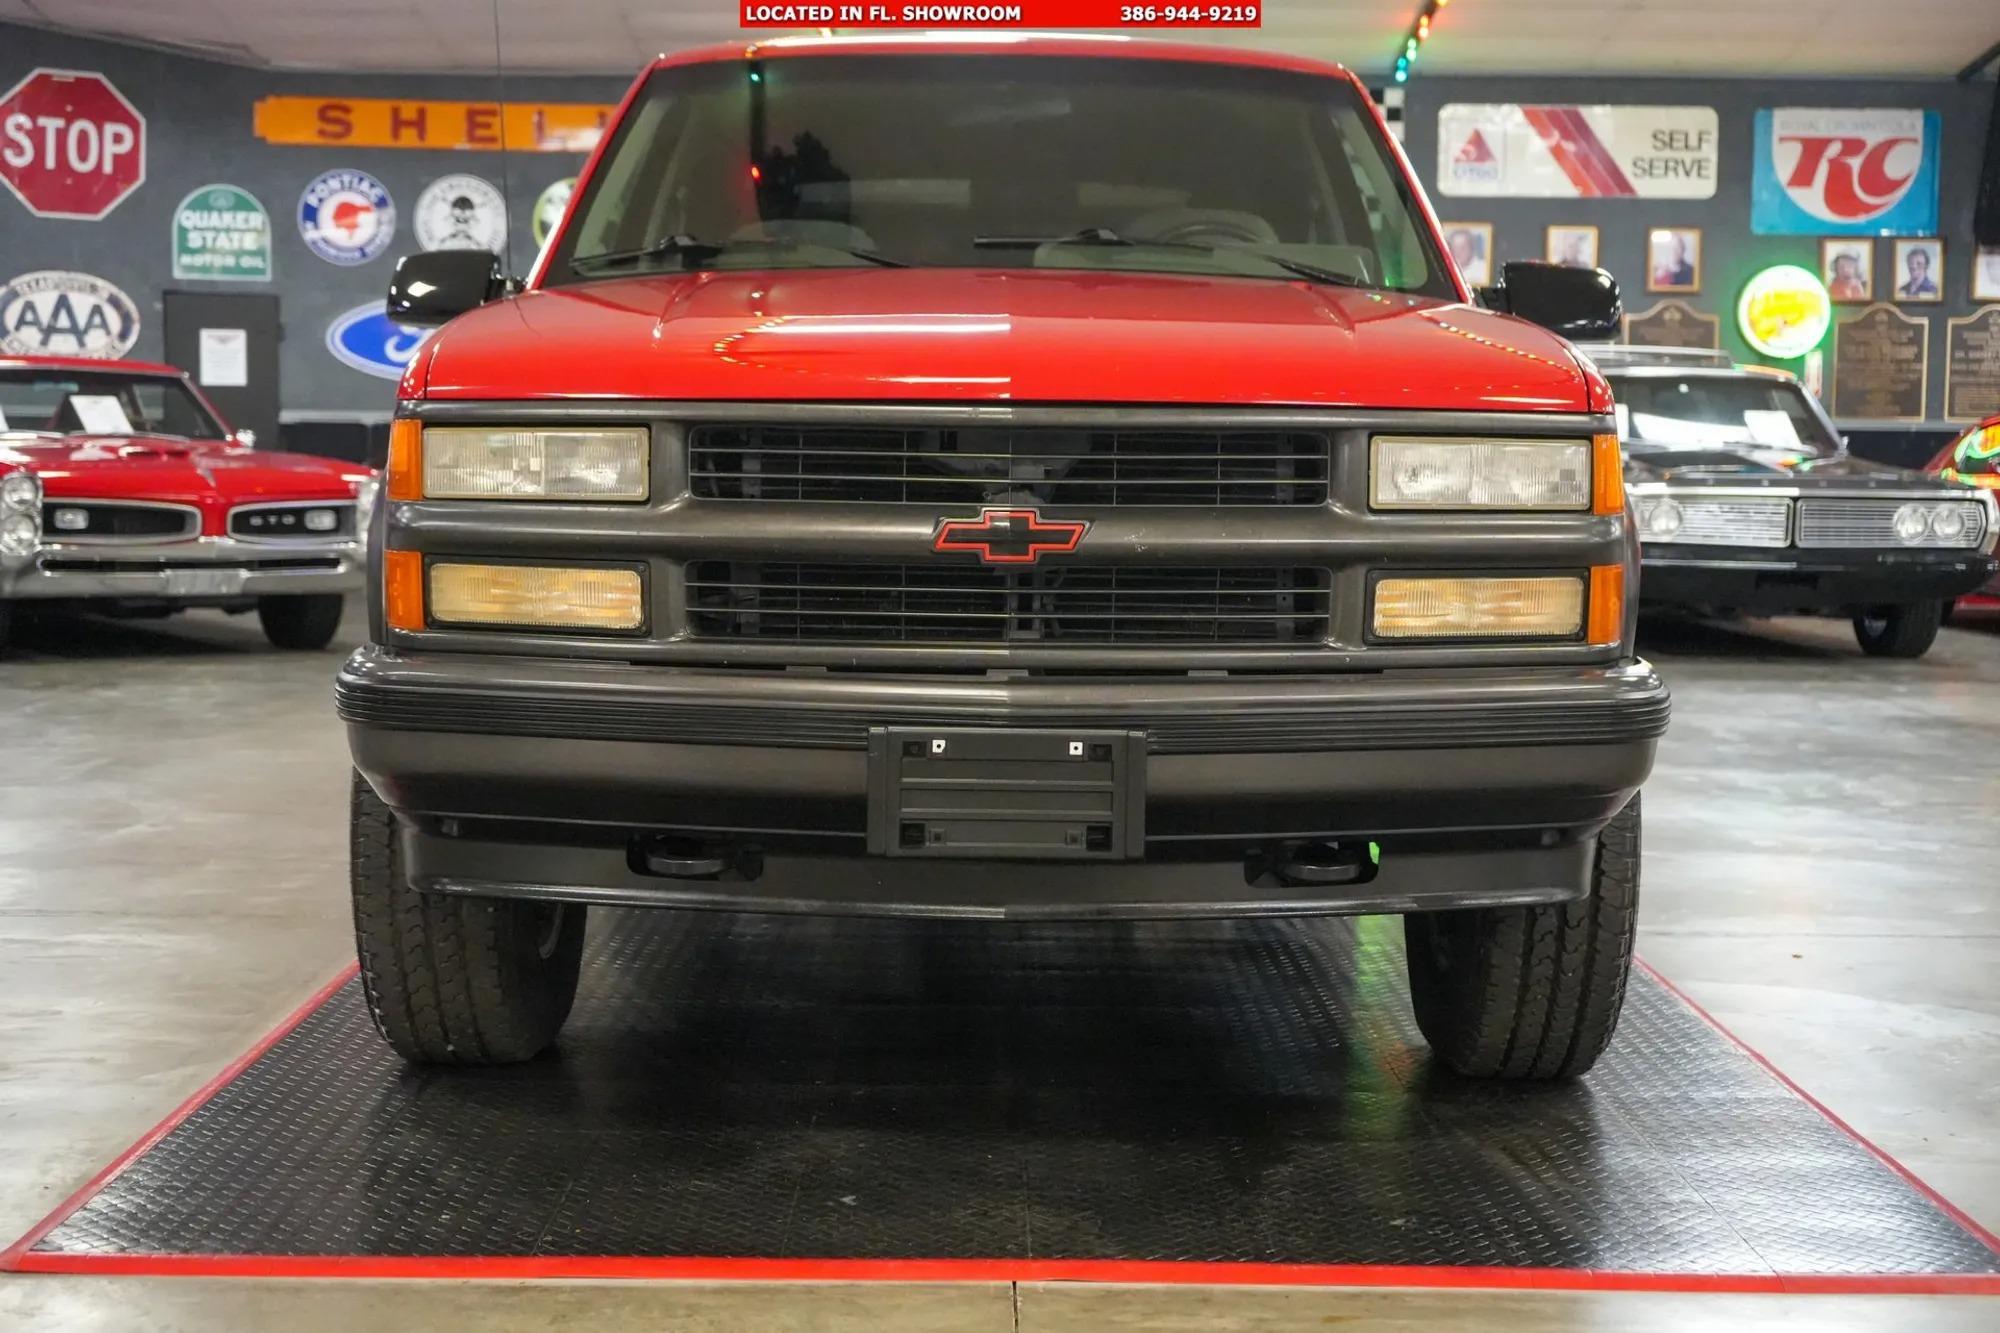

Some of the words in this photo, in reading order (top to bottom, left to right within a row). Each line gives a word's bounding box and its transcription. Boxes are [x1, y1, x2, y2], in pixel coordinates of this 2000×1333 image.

[3, 112, 134, 175] STOP
[1652, 129, 1712, 152] SELF
[1632, 157, 1712, 180] SERVE
[1779, 136, 1919, 219] RC
[305, 173, 385, 208] PONTIAC
[180, 209, 264, 230] QUAKER
[187, 230, 259, 250] STATE
[180, 253, 237, 267] MOTOR
[239, 255, 266, 268] OIL
[14, 293, 112, 348] AAA
